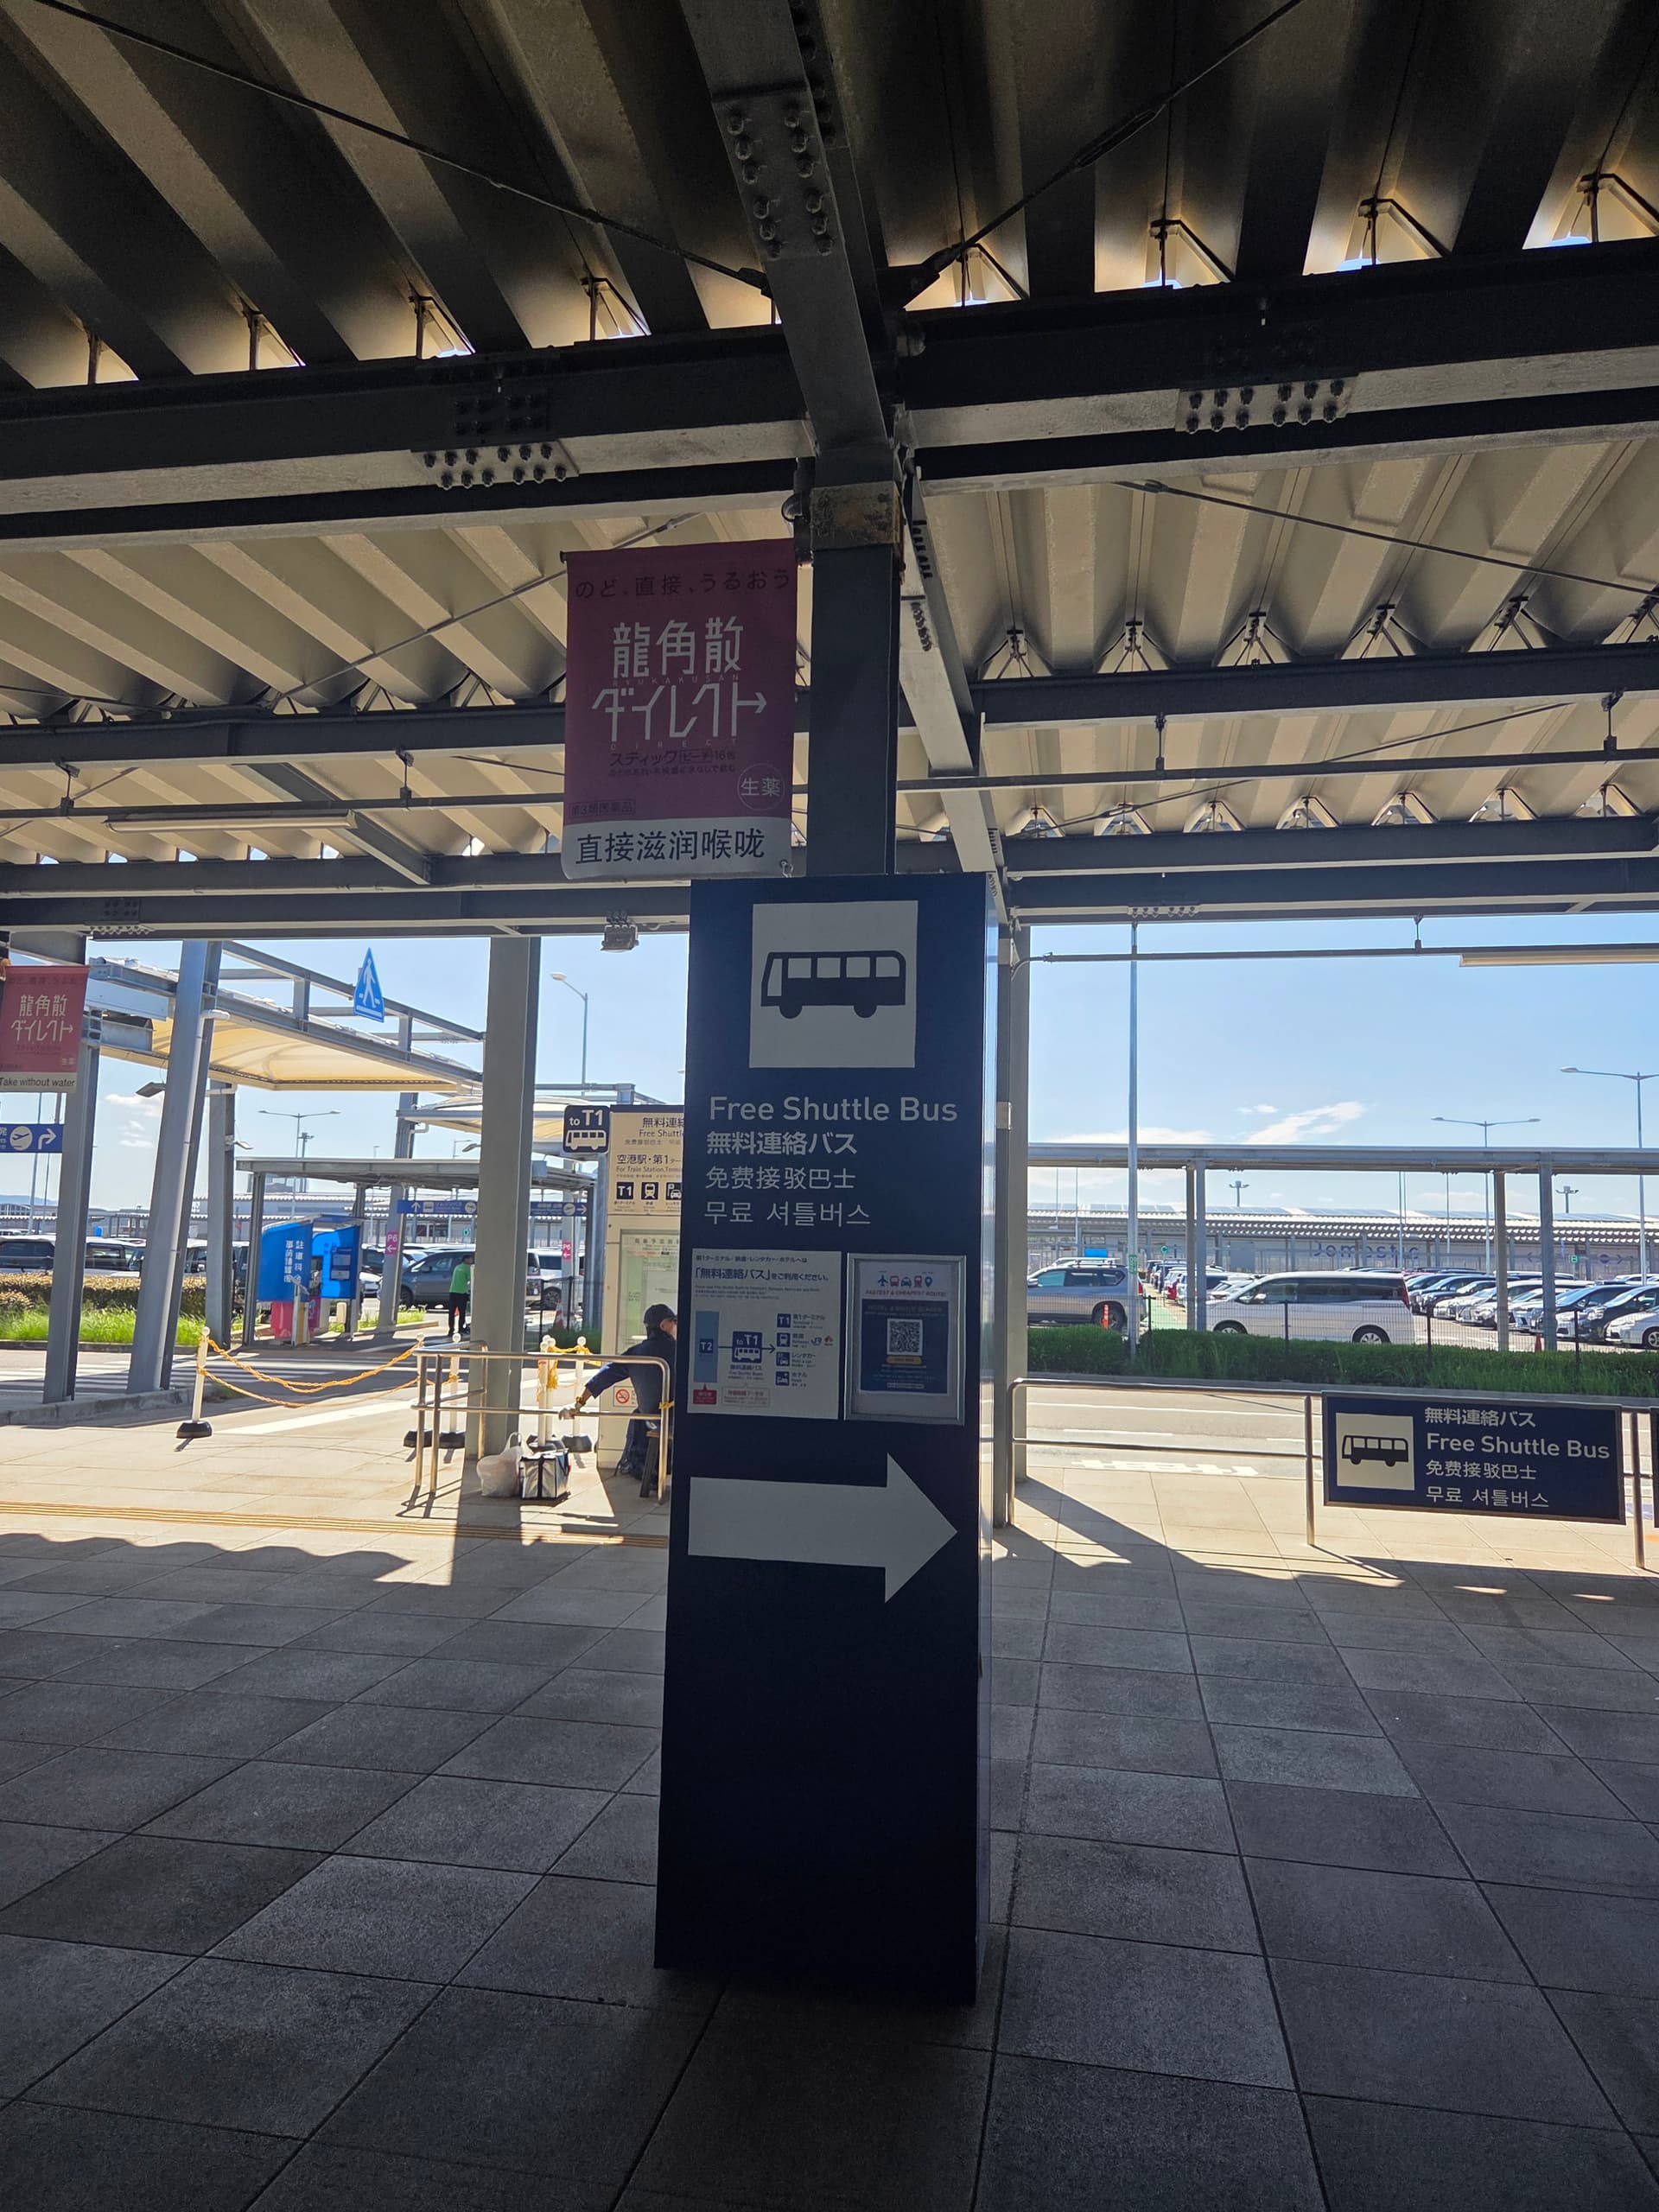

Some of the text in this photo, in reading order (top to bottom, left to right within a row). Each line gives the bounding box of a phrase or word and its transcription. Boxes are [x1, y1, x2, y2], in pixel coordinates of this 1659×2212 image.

[613, 616, 743, 678] 龍角散
[592, 682, 766, 741] ダイレクト
[740, 777, 781, 798] 生薬
[575, 827, 766, 865] 直接滋润喉咙
[19, 994, 67, 1018] 龍角散
[10, 1019, 74, 1043] ダイレクト
[0, 1077, 75, 1087] Take without water
[569, 1109, 603, 1126] to T1
[709, 1096, 958, 1122] Free Shuttle Bus
[639, 1128, 655, 1137] Free
[706, 1130, 858, 1156] 無料連絡バス
[704, 1166, 856, 1190] 免费接驳巴士
[618, 1185, 632, 1197] T1
[703, 1201, 754, 1225] 무료
[766, 1200, 871, 1228] 셔틀버스
[386, 1234, 397, 1243] P6
[778, 1315, 790, 1325] T1
[700, 1342, 713, 1351] T2
[744, 1334, 759, 1346] T1
[1424, 1406, 1536, 1427] 無料連絡バス
[1427, 1432, 1611, 1459] Free Shuttle Bus
[1425, 1459, 1537, 1480] 免费接驳巴士
[1426, 1485, 1549, 1509] 무료 셔틀버스
